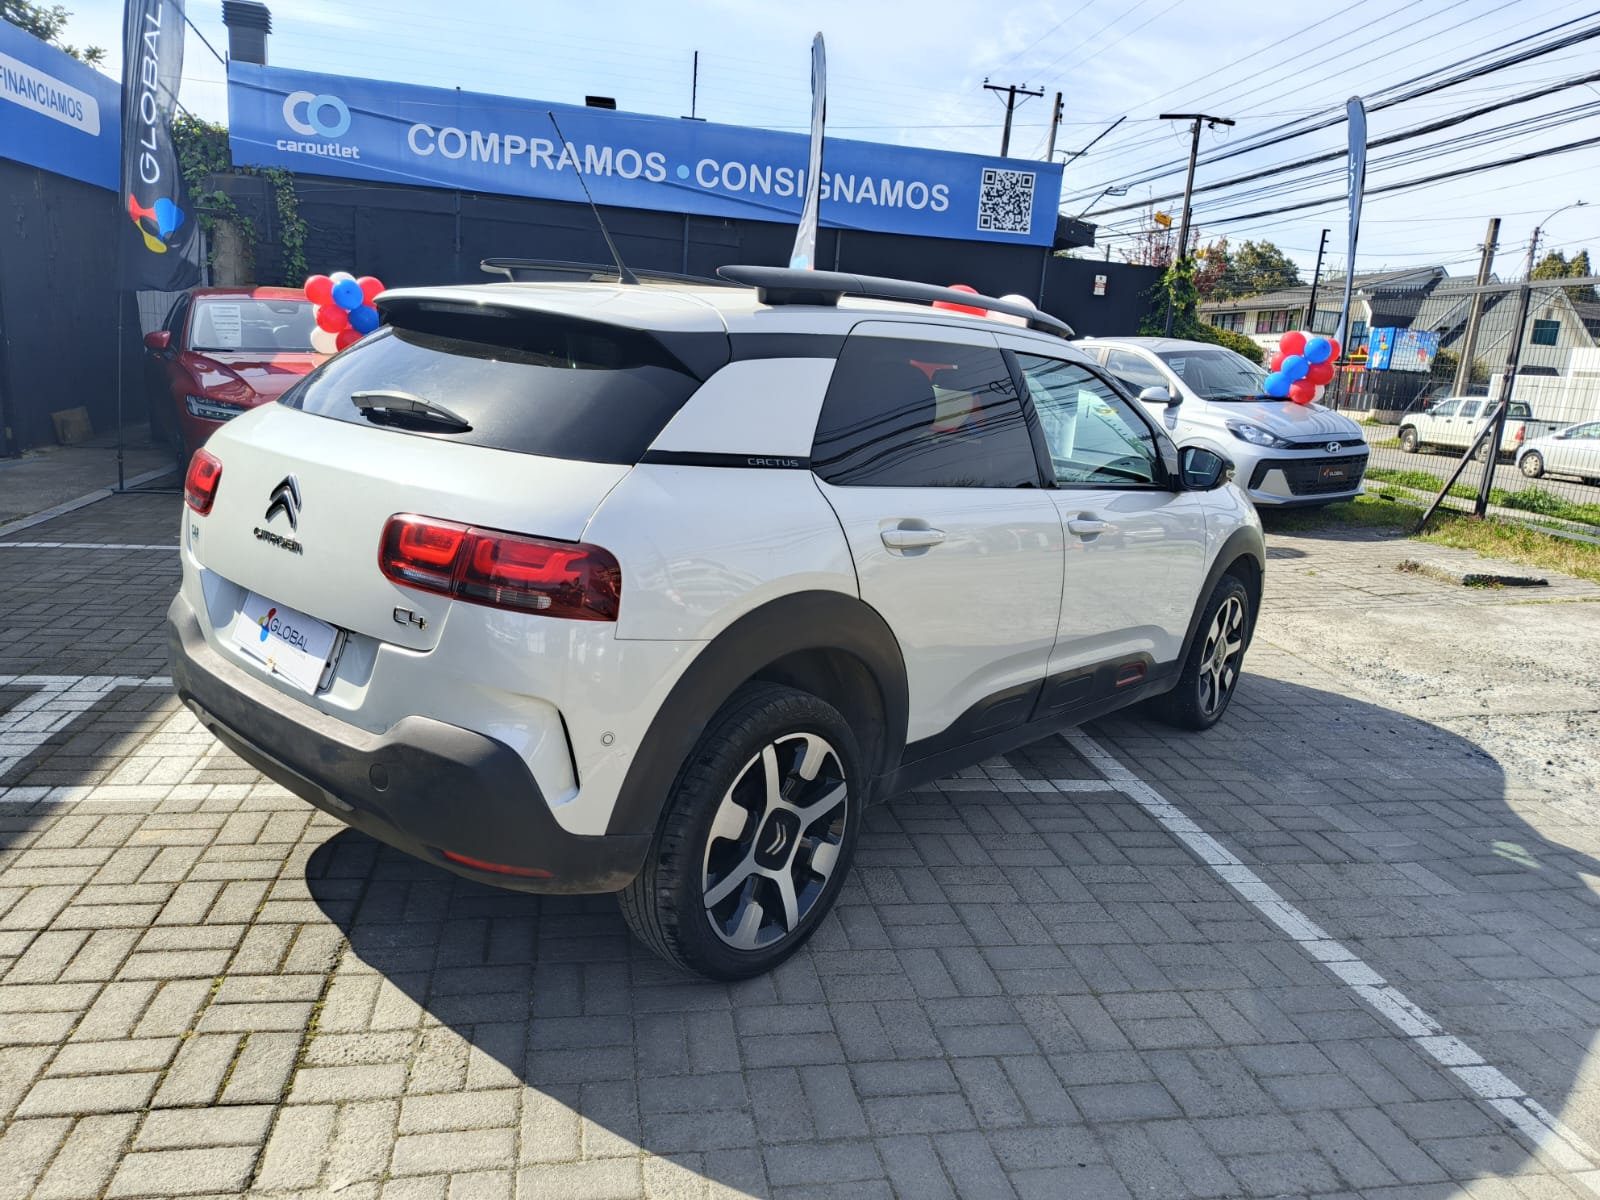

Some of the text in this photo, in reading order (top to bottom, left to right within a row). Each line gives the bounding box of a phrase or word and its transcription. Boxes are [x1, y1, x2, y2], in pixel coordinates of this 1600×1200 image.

[139, 3, 164, 185] GLOBAL
[276, 138, 361, 160] caroutlet
[407, 123, 667, 182] COMPRAMOS
[747, 457, 799, 468] CACTUS
[393, 606, 428, 630] C4
[270, 617, 308, 653] GLOBAL
